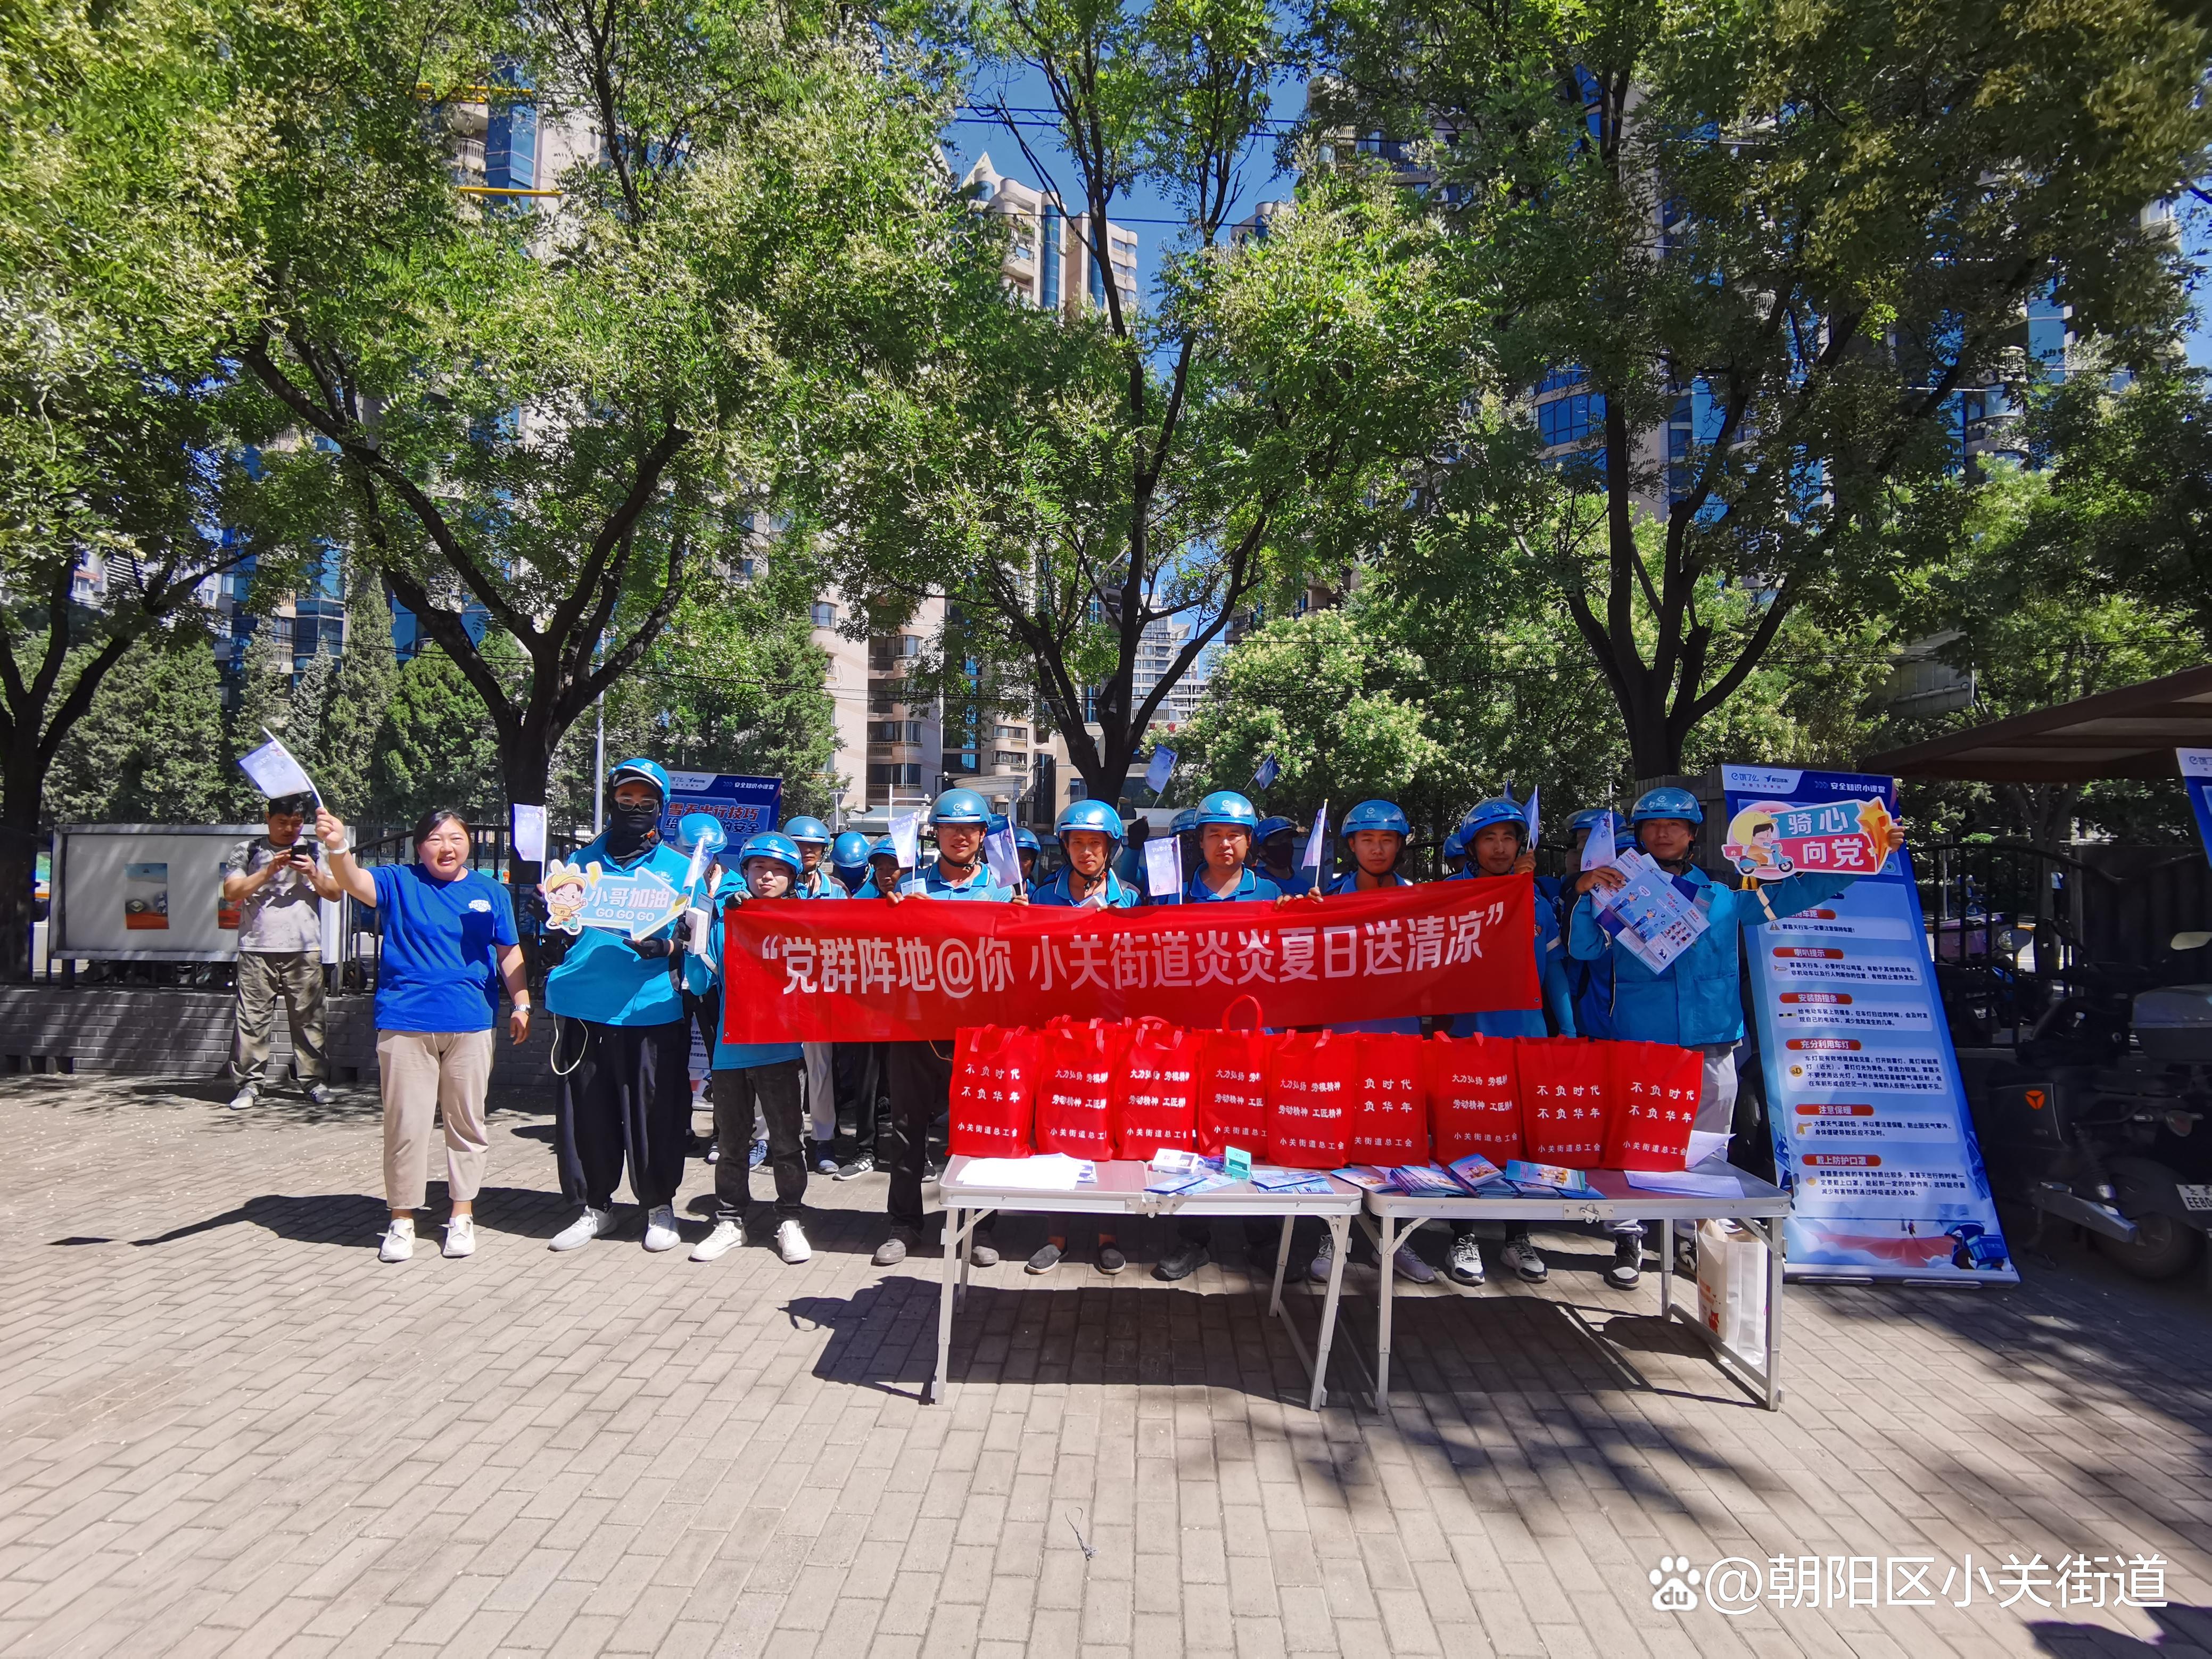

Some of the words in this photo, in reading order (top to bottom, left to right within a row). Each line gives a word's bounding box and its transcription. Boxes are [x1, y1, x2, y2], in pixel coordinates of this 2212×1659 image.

[734, 781, 775, 790] 安全知识小课堂
[1830, 782, 1886, 794] 安全知识小课堂
[1788, 807, 1848, 835] 骑心
[1802, 838, 1864, 868] 向党
[588, 886, 671, 910] 小哥加油
[596, 907, 614, 919] GO
[616, 909, 635, 920] GO
[636, 911, 655, 922] GO
[1793, 948, 1826, 958] 喇叭提示
[1797, 994, 1837, 1003] 安装防撞条
[1800, 1039, 1850, 1050] 充分利用车灯
[965, 1063, 1020, 1080] 不负时代
[1280, 1078, 1307, 1091] 大力弘扬
[1356, 1078, 1413, 1090] 负时代
[1452, 1074, 1483, 1086] 大力弘扬
[961, 1086, 1020, 1104] 不负华年
[1536, 1085, 1600, 1096] 不负时代
[1630, 1082, 1695, 1101] 不负时代
[1355, 1100, 1413, 1113] 负华年
[1537, 1107, 1600, 1119] 不负华年
[1818, 1105, 1852, 1115] 注意保暖
[1628, 1104, 1693, 1124] 不负华年
[958, 1121, 1018, 1137] 小关街道总工会
[1050, 1127, 1107, 1140] 小关街道总工
[1280, 1137, 1344, 1150] 小关街道总工会
[1454, 1132, 1517, 1143] 小关街道总工会
[1538, 1143, 1601, 1153] 小关街道总工会
[1623, 1140, 1687, 1156] 小关街道总工会
[1815, 1155, 1867, 1166] 戴上防护口罩
